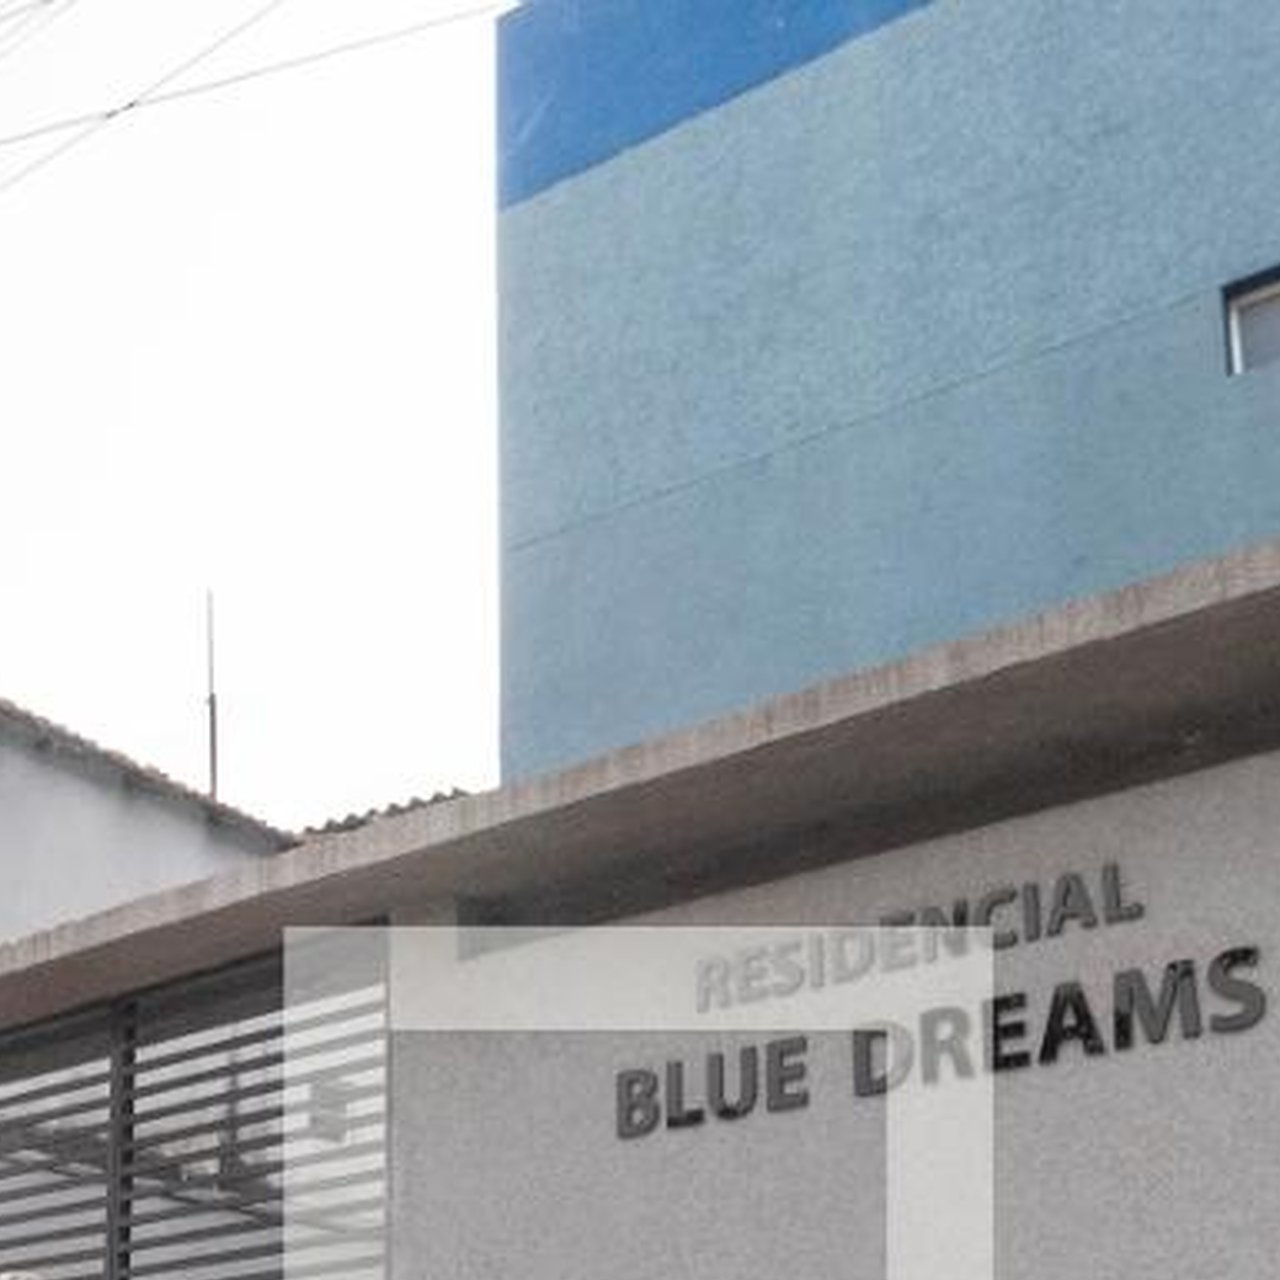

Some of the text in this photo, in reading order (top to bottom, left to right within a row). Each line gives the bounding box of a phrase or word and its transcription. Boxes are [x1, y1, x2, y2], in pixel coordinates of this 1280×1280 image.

[695, 862, 1145, 1014] RESIDENCIAL
[616, 945, 1269, 1141] BLUE DREAMS
